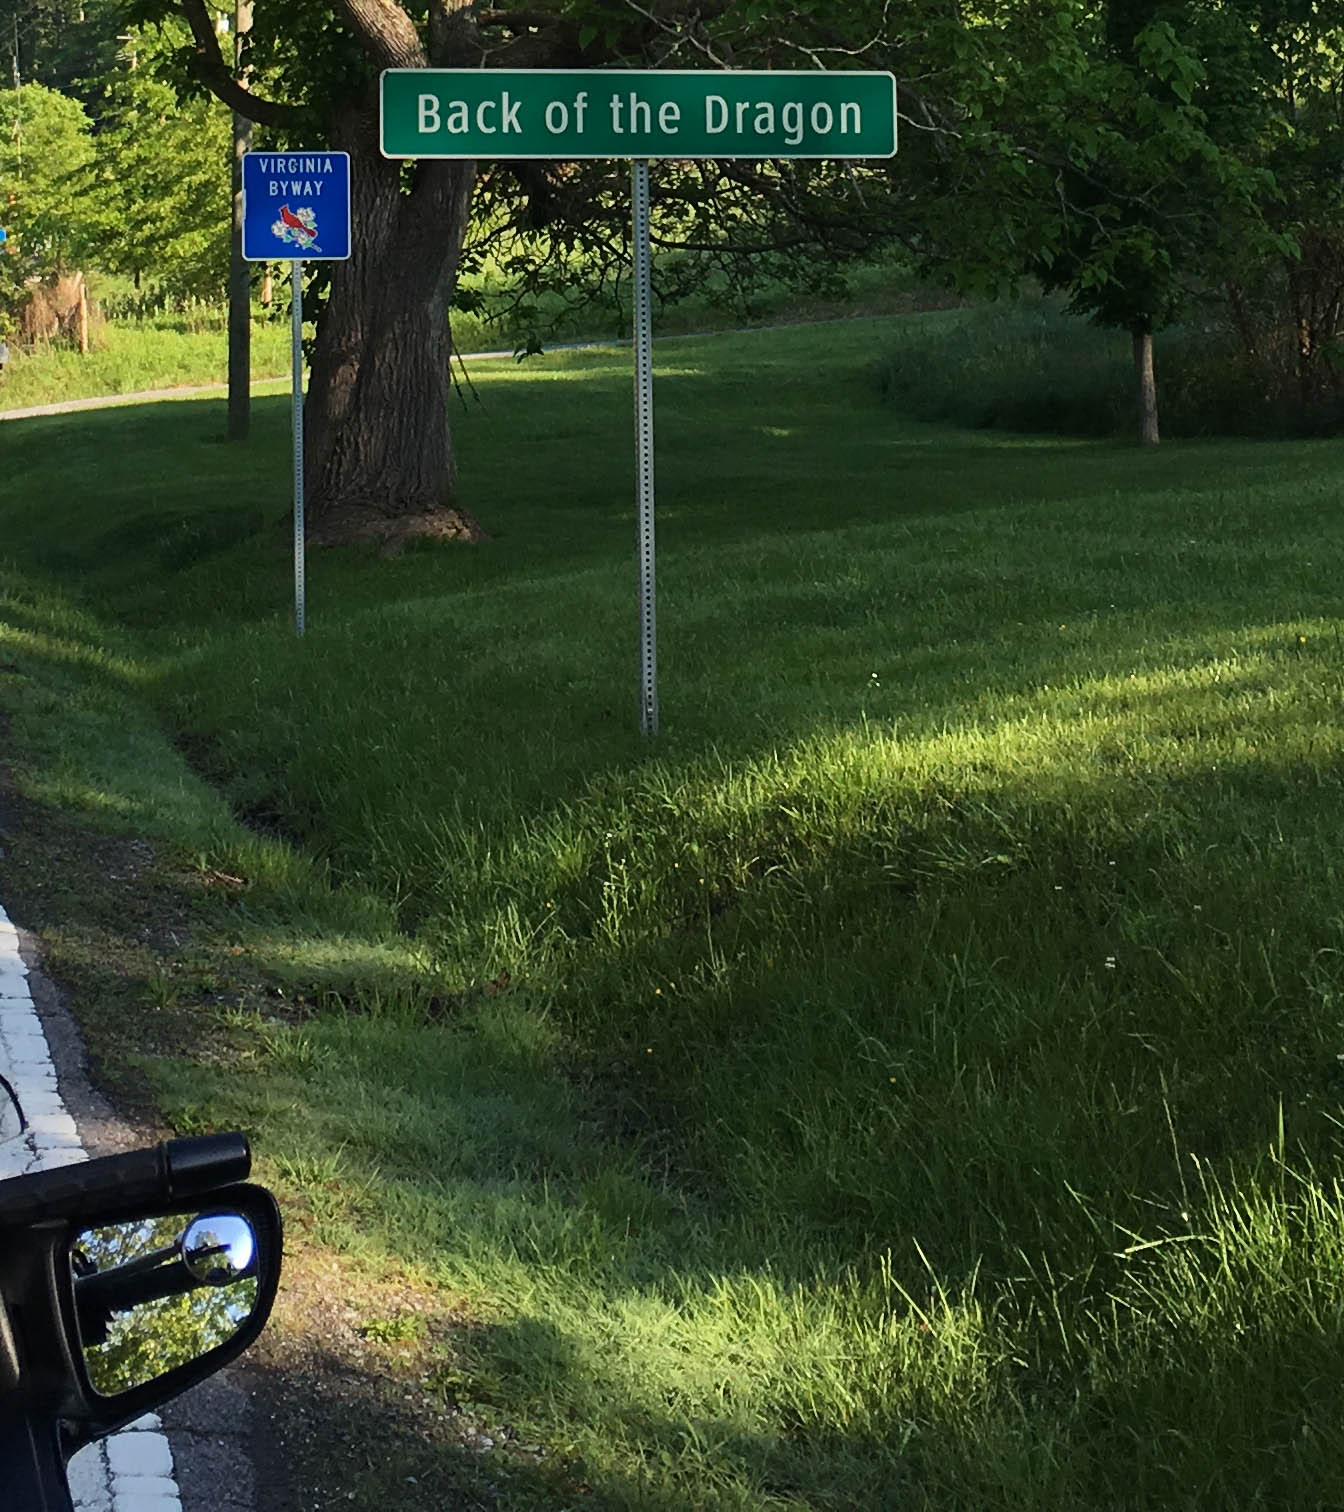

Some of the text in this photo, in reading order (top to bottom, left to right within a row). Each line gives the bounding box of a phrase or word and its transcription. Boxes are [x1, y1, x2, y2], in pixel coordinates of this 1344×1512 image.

[417, 91, 864, 146] Back of the Dragon
[259, 157, 333, 174] VIRGINIA
[269, 180, 324, 196] BYWAY
